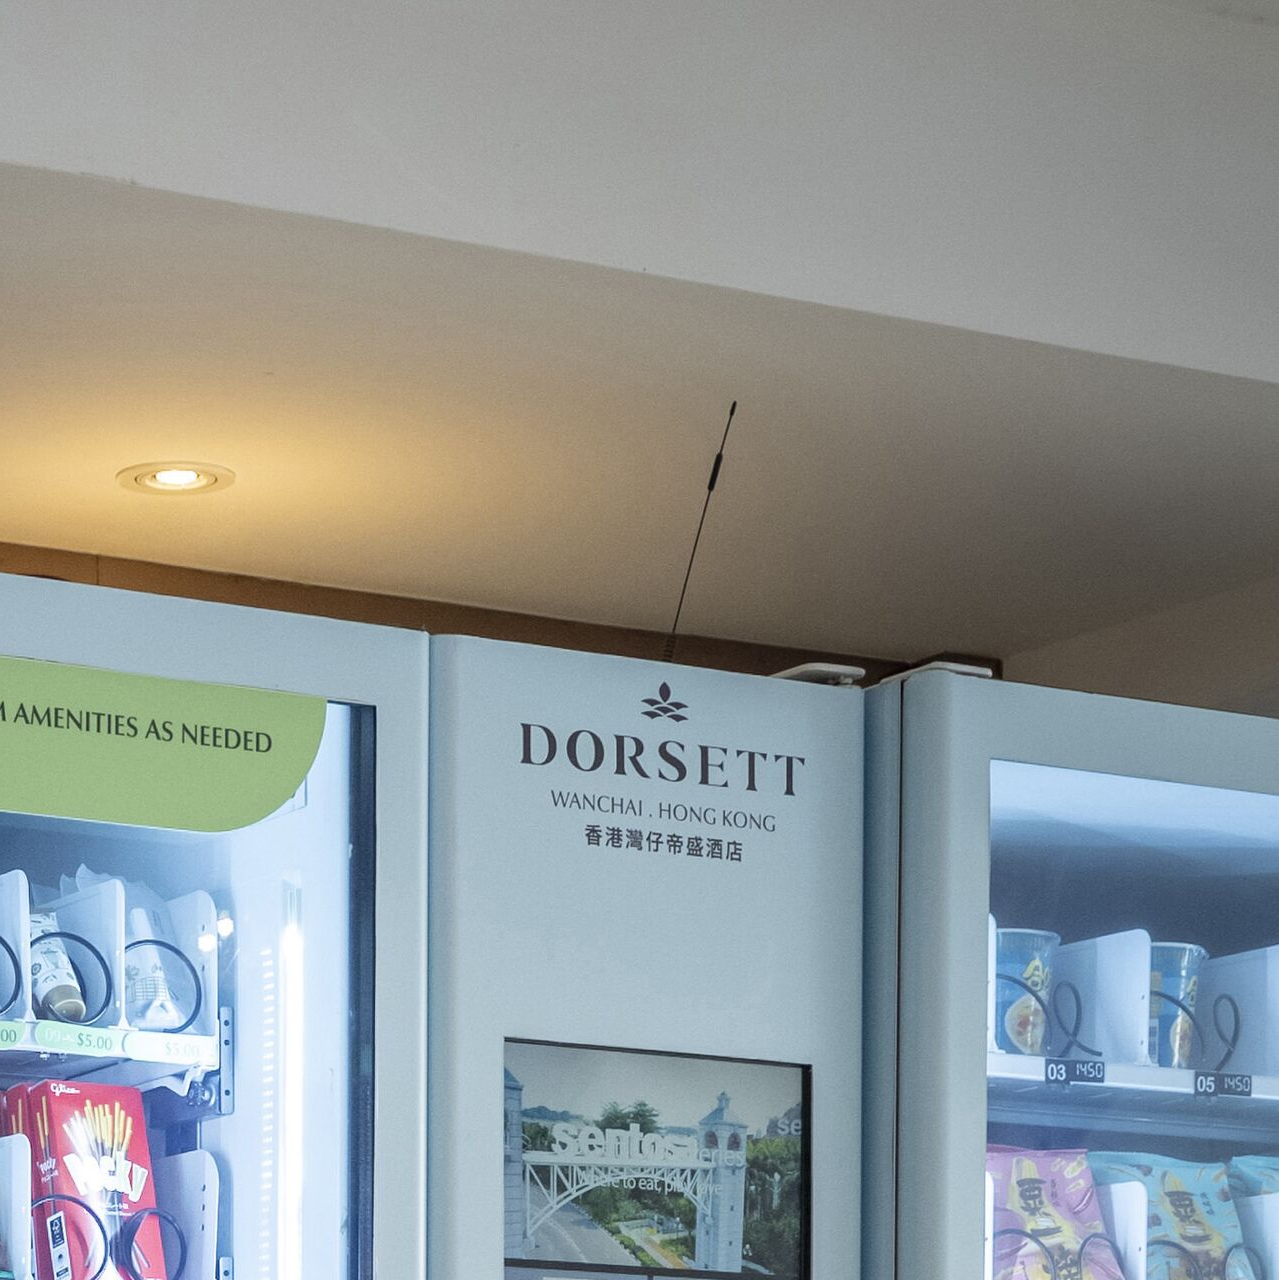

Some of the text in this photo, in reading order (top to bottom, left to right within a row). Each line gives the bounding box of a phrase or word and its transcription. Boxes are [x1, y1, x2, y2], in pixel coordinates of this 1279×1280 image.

[13, 702, 138, 738] AMENITIES
[145, 718, 173, 743] AS
[181, 721, 273, 754] NEEDED
[520, 722, 806, 797] DORSETT
[658, 801, 716, 826] HONG
[723, 809, 776, 833] KONG
[585, 823, 743, 863] 香港灣仔帝盛酒店
[77, 1033, 112, 1050] $5.00
[1048, 1064, 1066, 1081] 03
[50, 1083, 81, 1096] Glico
[1197, 1076, 1215, 1093] 05
[623, 1177, 636, 1189] to
